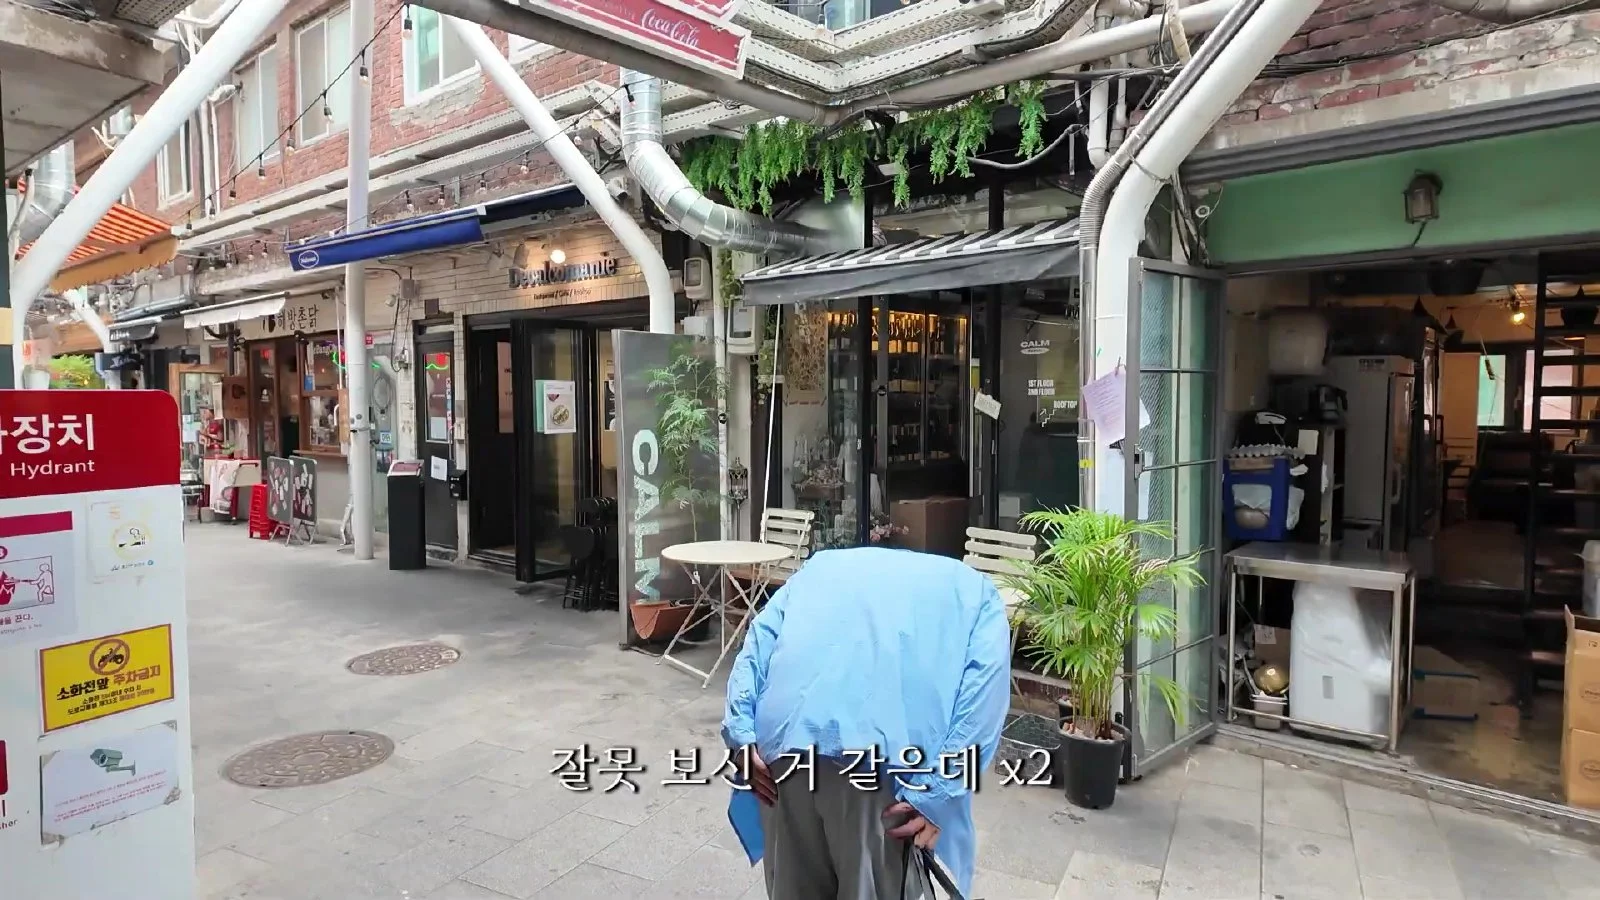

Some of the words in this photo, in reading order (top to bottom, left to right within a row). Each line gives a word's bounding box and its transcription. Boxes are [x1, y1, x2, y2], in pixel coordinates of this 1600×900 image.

[508, 258, 616, 288] Decalcomanie
[1020, 340, 1050, 348] CALM
[1053, 400, 1078, 409] ROOFTOP
[10, 459, 96, 480] Hydrant
[632, 429, 660, 605] CALM
[56, 676, 110, 701] 소화전앞
[114, 664, 161, 687] 주차금지
